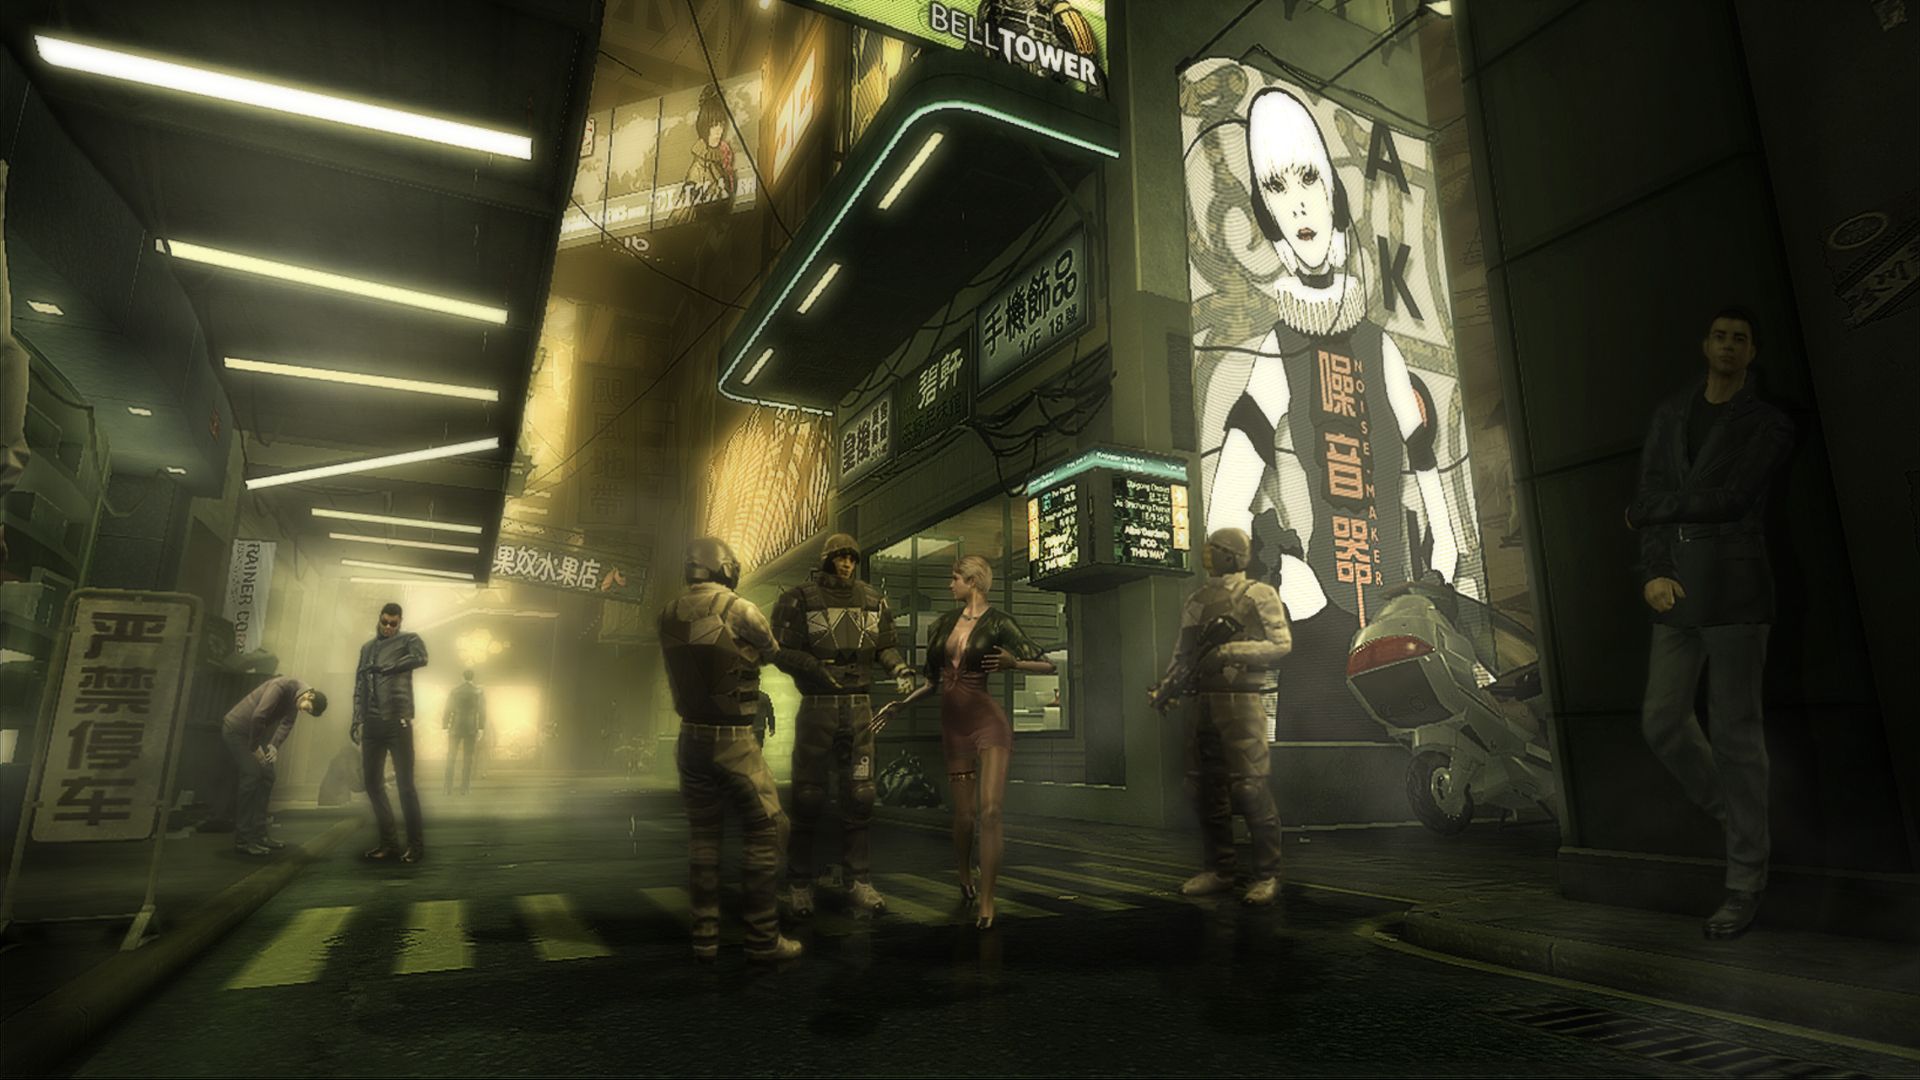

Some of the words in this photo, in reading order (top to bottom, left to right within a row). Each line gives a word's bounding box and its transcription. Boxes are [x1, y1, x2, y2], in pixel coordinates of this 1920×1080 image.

[983, 249, 1077, 357] 手機飾品
[1019, 328, 1042, 357] 1/F
[1317, 350, 1373, 630] 噪音器
[238, 543, 261, 606] RAINER
[1130, 547, 1148, 558] THIS
[1148, 549, 1166, 560] WAY
[53, 612, 167, 827] 严禁停车
